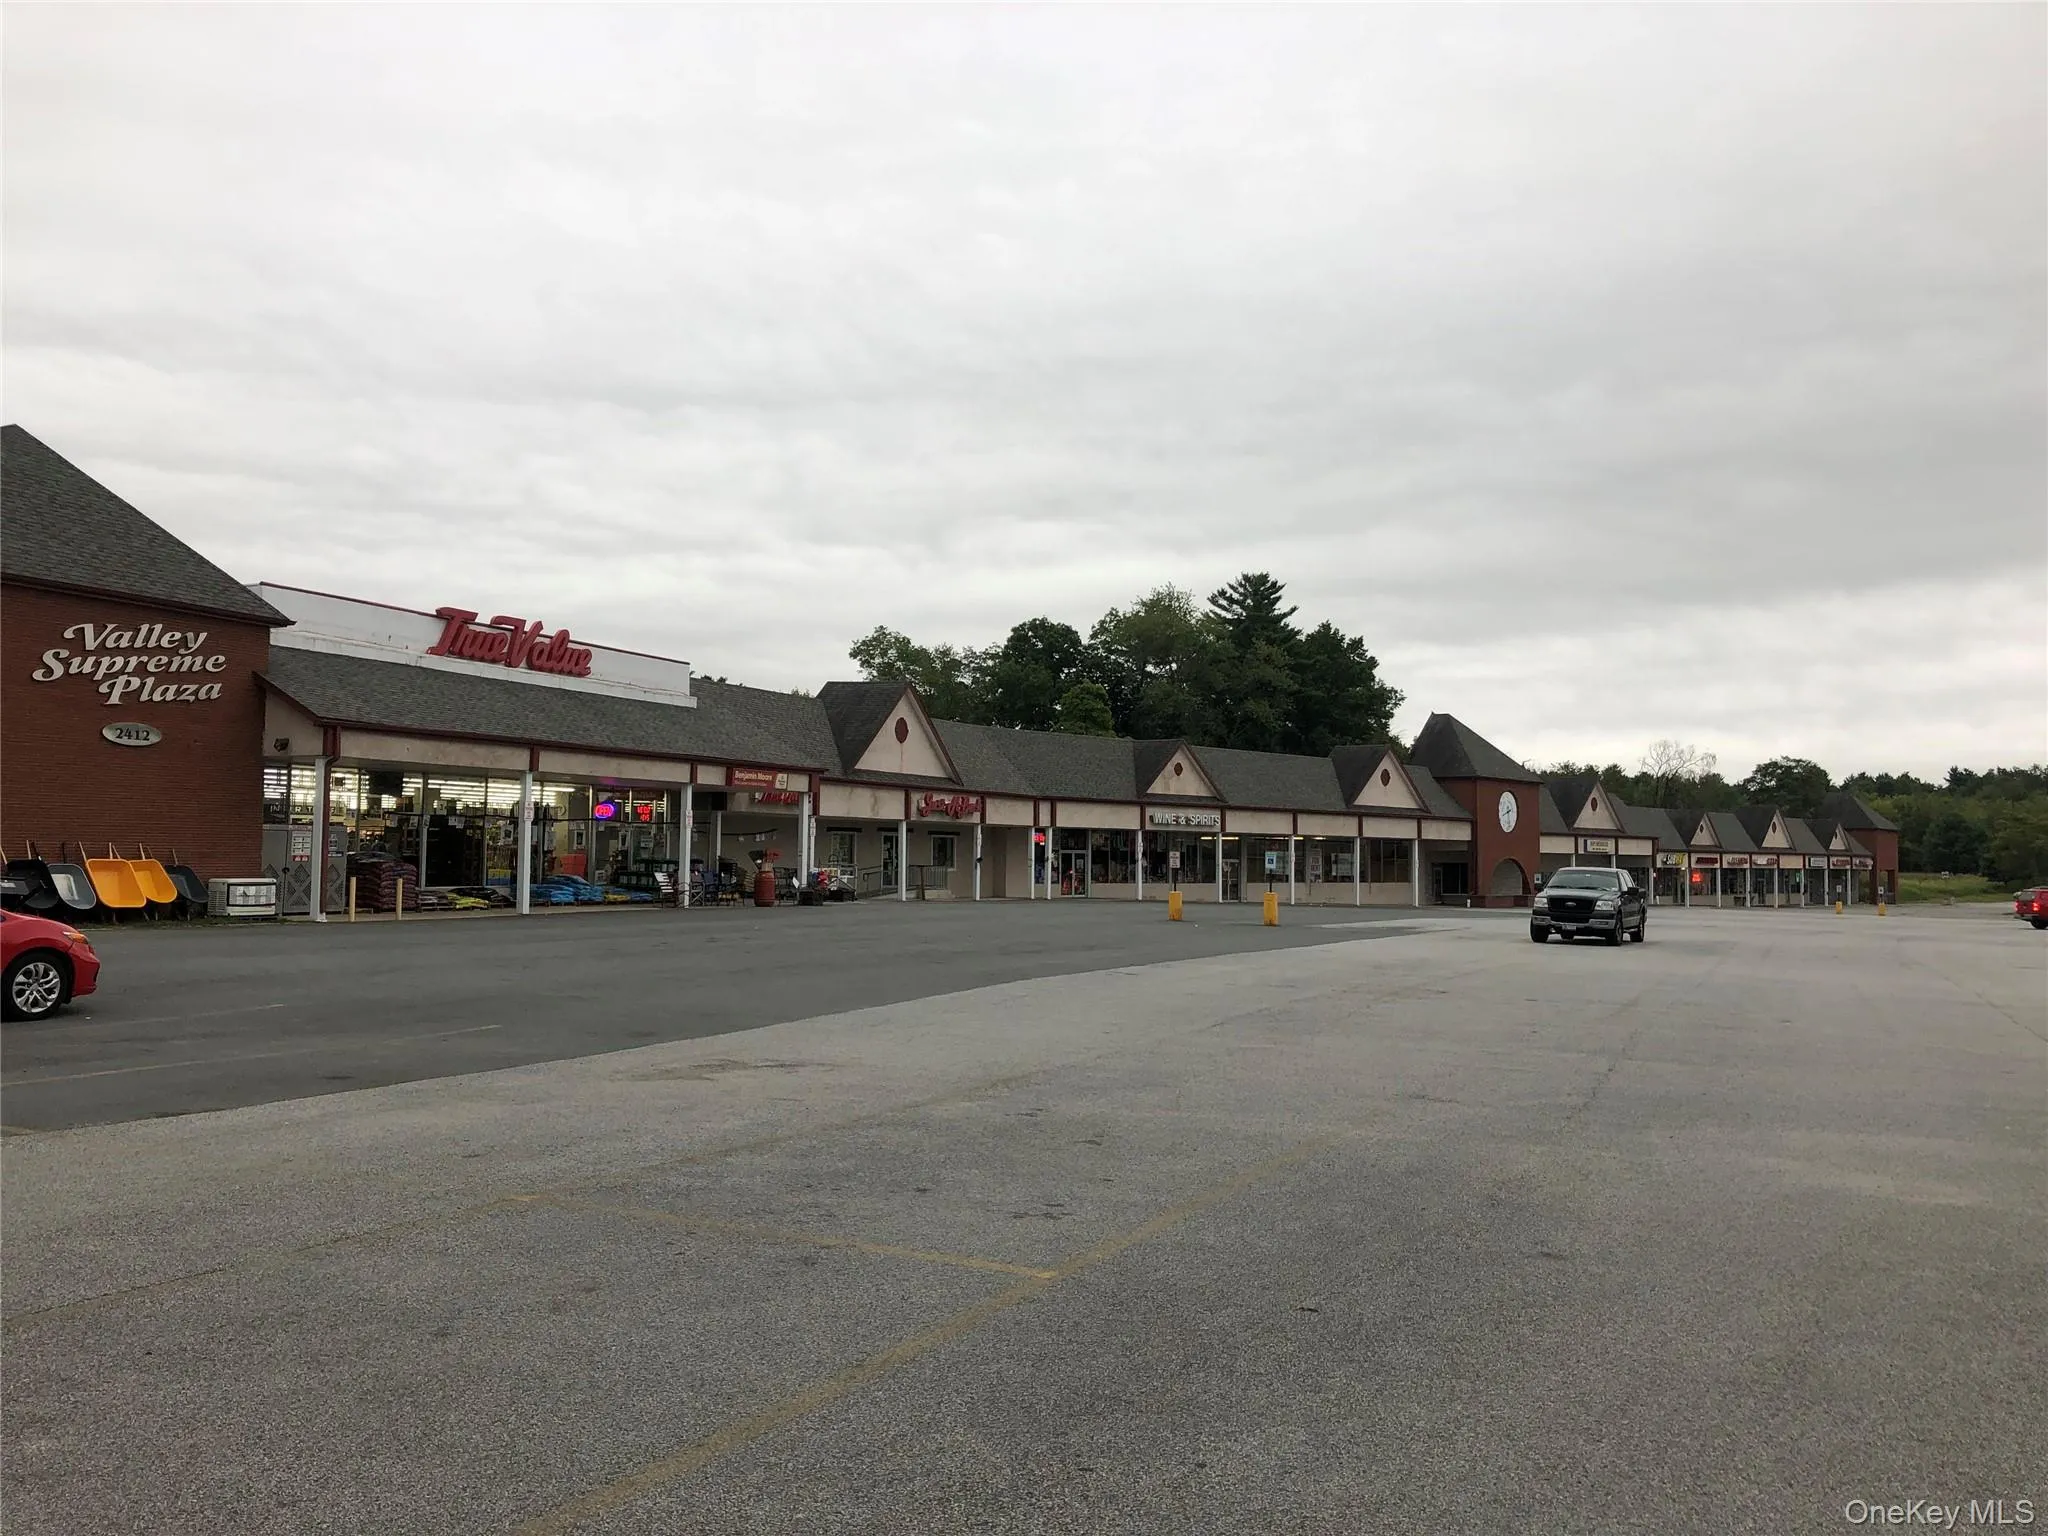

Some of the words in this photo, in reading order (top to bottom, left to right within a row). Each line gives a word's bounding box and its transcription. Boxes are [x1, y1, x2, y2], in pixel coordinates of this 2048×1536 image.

[63, 623, 208, 655] Valley
[427, 606, 509, 663] True
[490, 615, 593, 678] Value
[32, 648, 227, 682] Supreme
[98, 674, 223, 705] Plaza
[115, 727, 150, 741] 2412
[1152, 812, 1177, 825] WINE
[1179, 814, 1187, 825] &
[1190, 814, 1221, 826] SPIRITS
